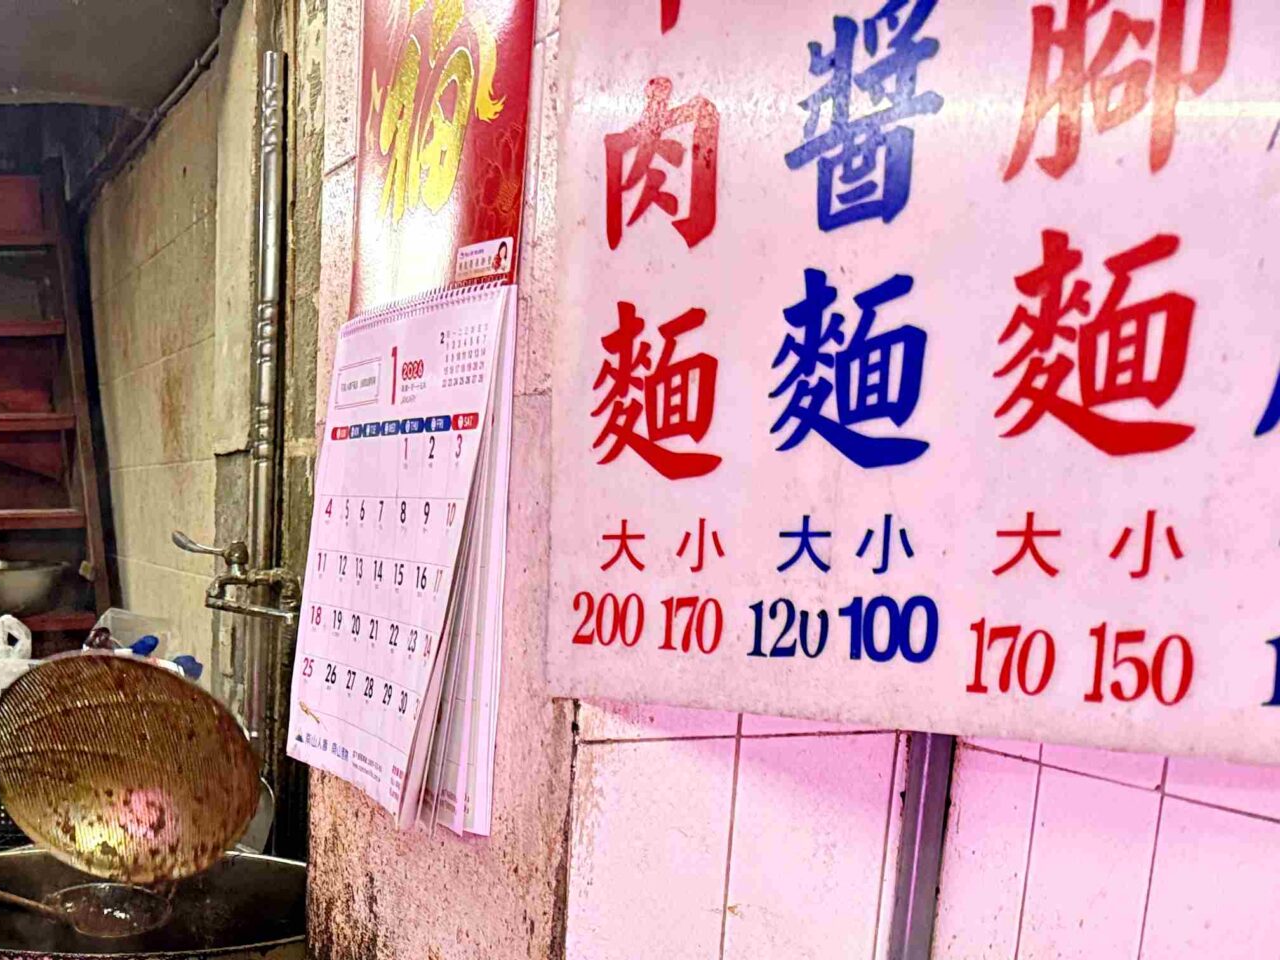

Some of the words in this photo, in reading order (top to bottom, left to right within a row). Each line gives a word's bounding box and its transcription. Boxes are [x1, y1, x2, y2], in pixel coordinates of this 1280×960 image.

[590, 0, 724, 481] 肉麵
[391, 346, 398, 405] 1
[402, 359, 424, 381] 2026
[428, 435, 436, 459] 2
[455, 433, 463, 459] 3
[325, 498, 333, 518] 4
[360, 499, 365, 521] 6
[378, 500, 384, 522] 7
[400, 501, 406, 523] 8
[424, 501, 430, 525] 9
[318, 552, 327, 572] 11
[339, 555, 347, 576] 12
[356, 557, 363, 579] 13
[374, 560, 383, 582] 14
[394, 563, 404, 586] 15
[416, 566, 427, 590] 16
[600, 519, 646, 573] 大
[676, 517, 726, 574] 小
[777, 515, 831, 574] 大
[856, 514, 914, 575] 小
[992, 511, 1061, 578] 大
[1109, 509, 1184, 579] 小
[310, 605, 322, 626] 18
[333, 609, 342, 630] 19
[351, 614, 360, 636] 20
[369, 618, 379, 641] 21
[388, 623, 399, 646] 22
[407, 629, 418, 653] 23
[571, 591, 645, 647] 200
[658, 595, 724, 656] 170
[747, 598, 829, 658] 120
[838, 595, 939, 664] 100
[302, 657, 314, 677] 25
[325, 663, 337, 684] 26
[345, 669, 356, 690] 27
[364, 676, 374, 699] 28
[382, 683, 392, 705] 29
[399, 690, 408, 714] 30
[965, 616, 1056, 697] 170
[1083, 621, 1195, 706] 150
